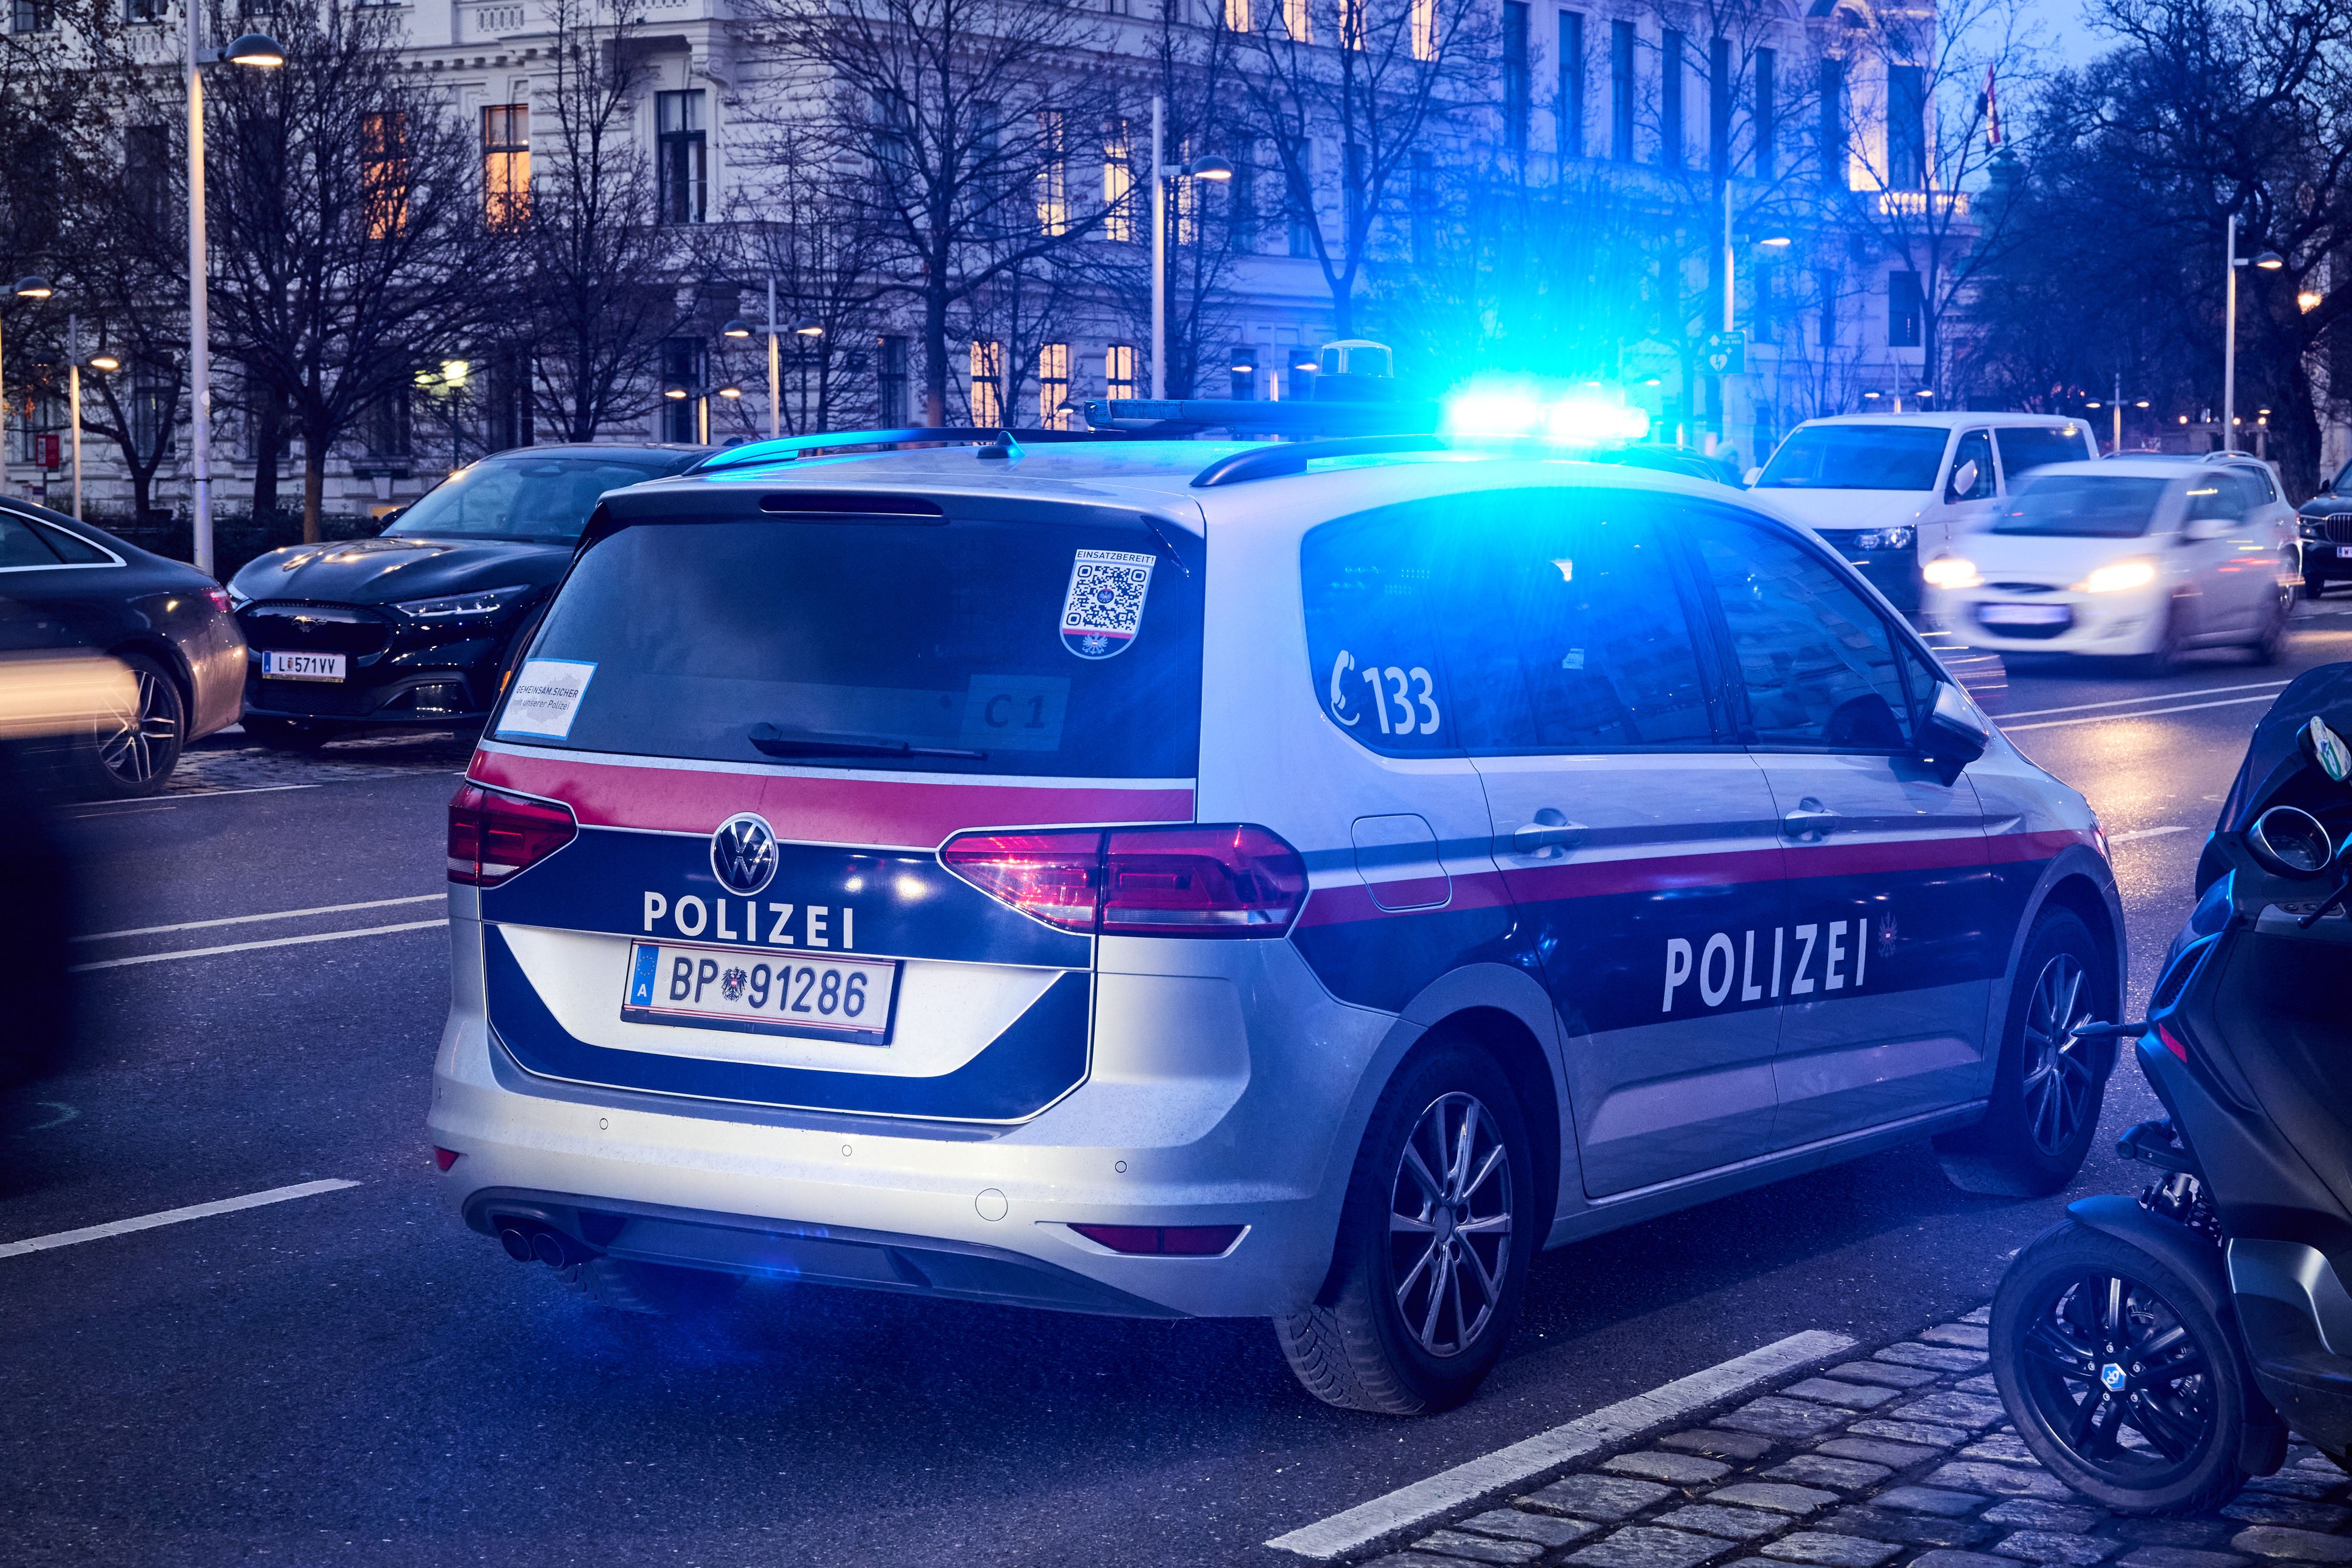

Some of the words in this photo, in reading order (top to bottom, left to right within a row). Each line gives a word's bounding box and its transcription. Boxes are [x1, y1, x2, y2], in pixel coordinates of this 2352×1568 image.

[1077, 551, 1154, 564] EINSATZBEREIT!
[279, 656, 285, 671] L
[295, 657, 335, 674] 571VV
[516, 686, 579, 698] GEMEINSAM.SICHER
[1362, 666, 1440, 735] 133
[523, 699, 547, 708] unserer
[547, 700, 570, 710] Polizei
[644, 891, 853, 949] POLIZEI
[1662, 918, 1867, 1012] POLIZEI
[636, 983, 647, 998] A
[670, 956, 719, 1004] BP
[748, 963, 867, 1018] 91286
